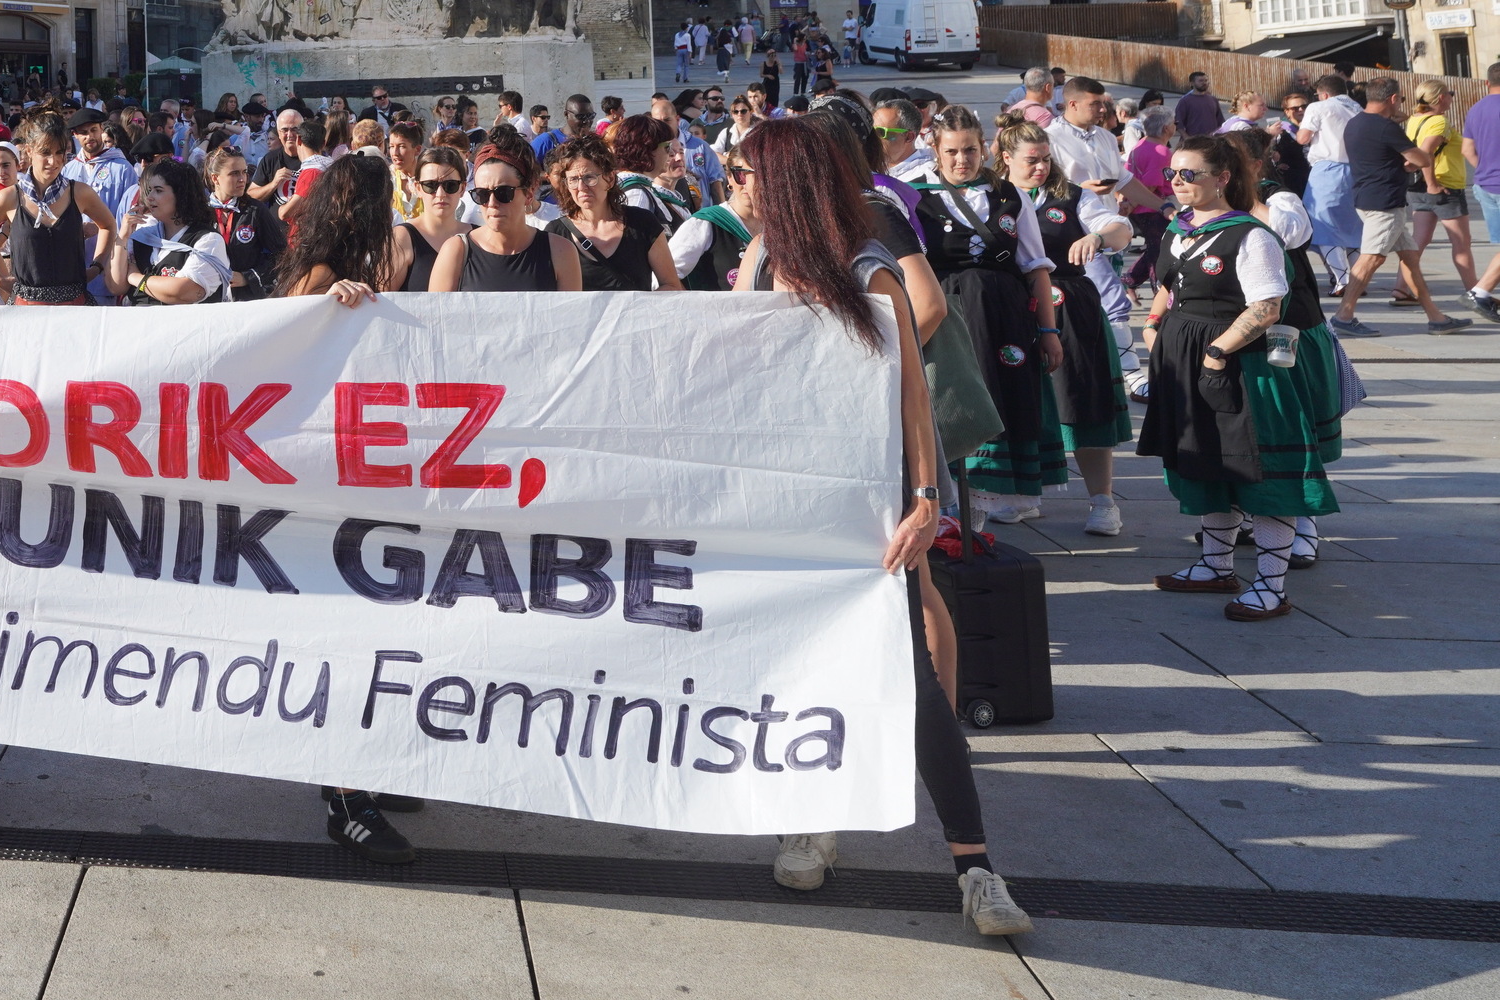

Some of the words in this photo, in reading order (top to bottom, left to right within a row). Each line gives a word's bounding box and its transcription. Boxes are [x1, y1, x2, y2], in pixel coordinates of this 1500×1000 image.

[335, 382, 547, 508] EZ,
[333, 517, 703, 632] GABE
[361, 650, 844, 775] Feminista
